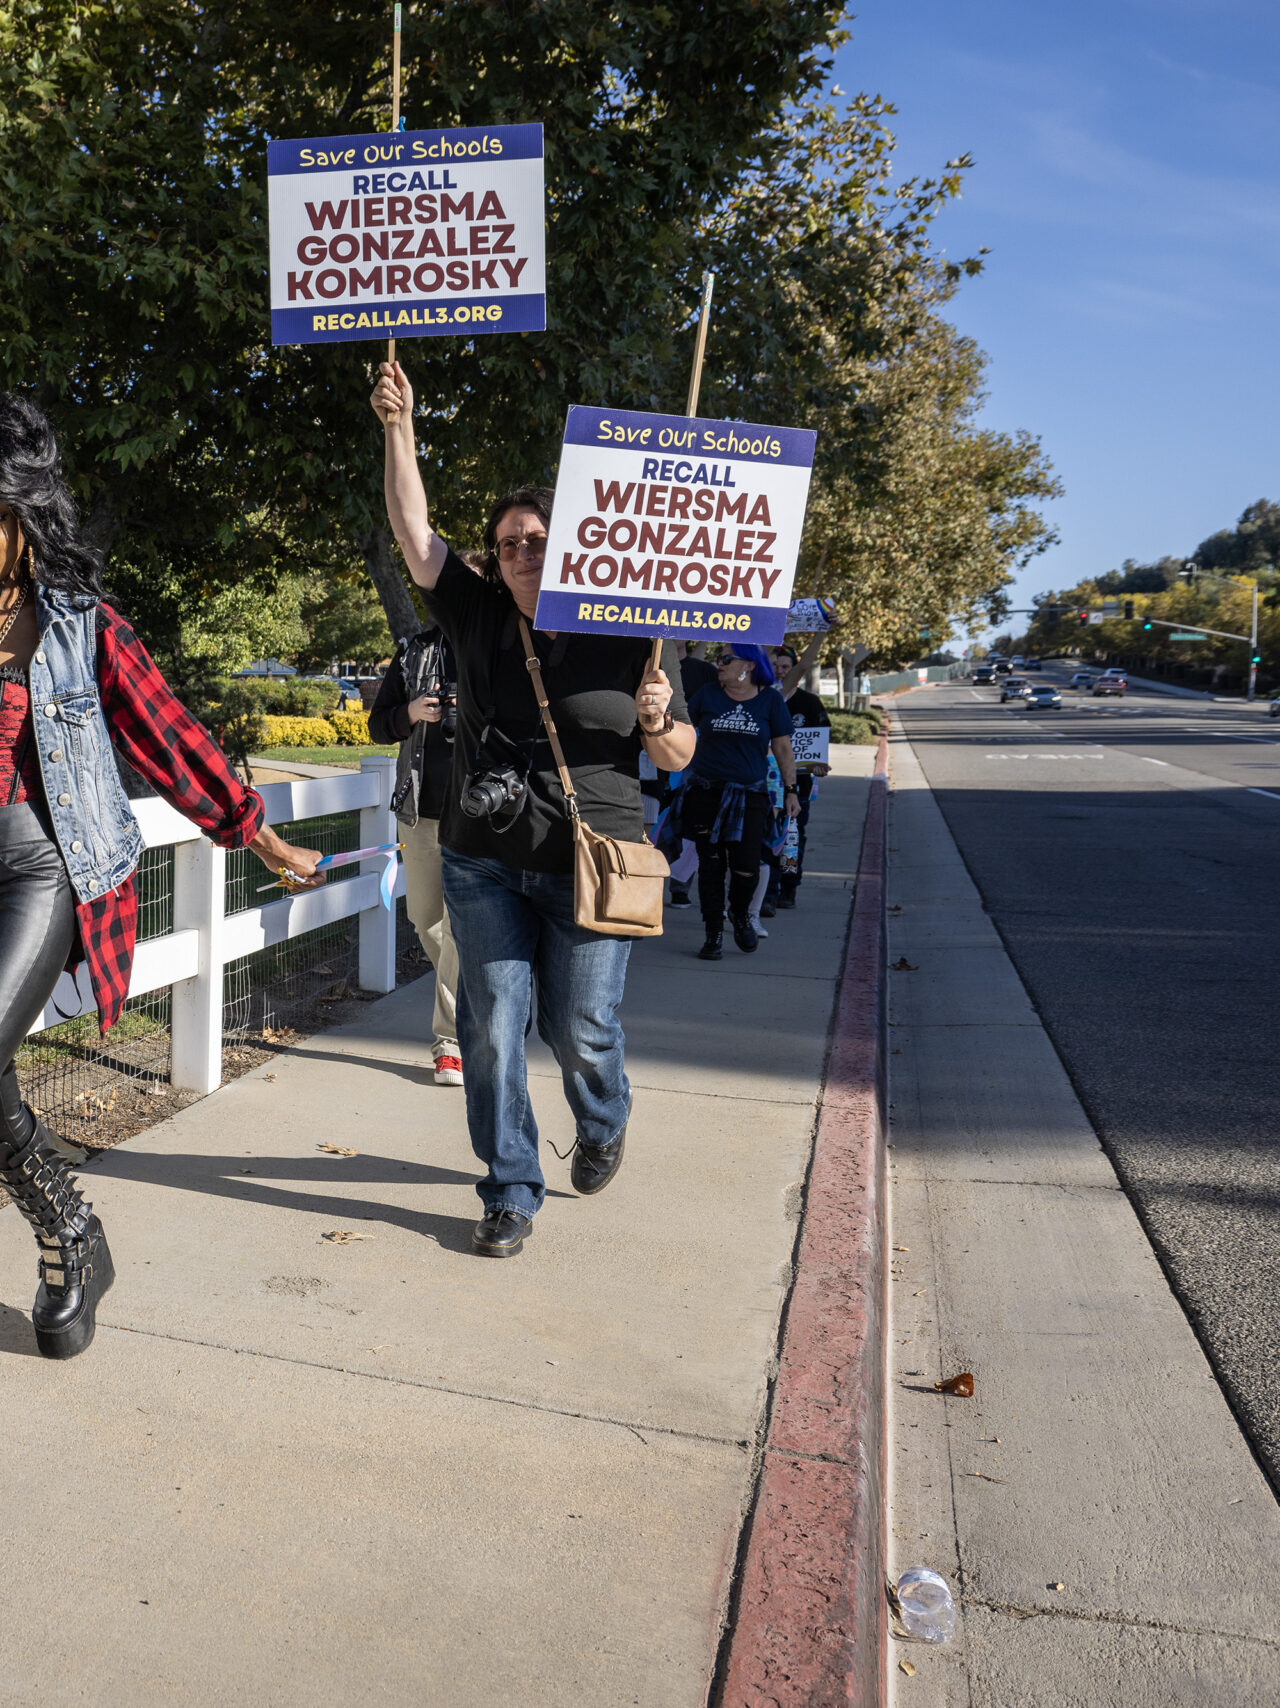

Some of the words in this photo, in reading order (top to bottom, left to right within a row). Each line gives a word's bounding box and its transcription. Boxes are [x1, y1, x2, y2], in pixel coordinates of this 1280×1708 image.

[300, 149, 356, 166] Save
[364, 142, 404, 163] Our
[412, 135, 503, 159] Schools
[353, 170, 457, 195] RECALL
[304, 190, 506, 230] WIERSMA
[297, 224, 515, 266] GONZALEZ
[287, 258, 528, 301] KOMROSKY
[313, 305, 503, 331] RECALLALL3.ORG
[597, 420, 652, 444] Save
[659, 429, 697, 448] Our
[702, 430, 781, 457] Schools
[642, 458, 736, 487] RECALL
[594, 479, 772, 526] WIERSMA
[577, 516, 777, 563] GONZALEZ
[560, 553, 782, 599] KOMROSKY
[578, 603, 751, 631] RECALLALL3.ORG
[713, 723, 760, 732] DEMOCRACY
[793, 745, 809, 753] OF
